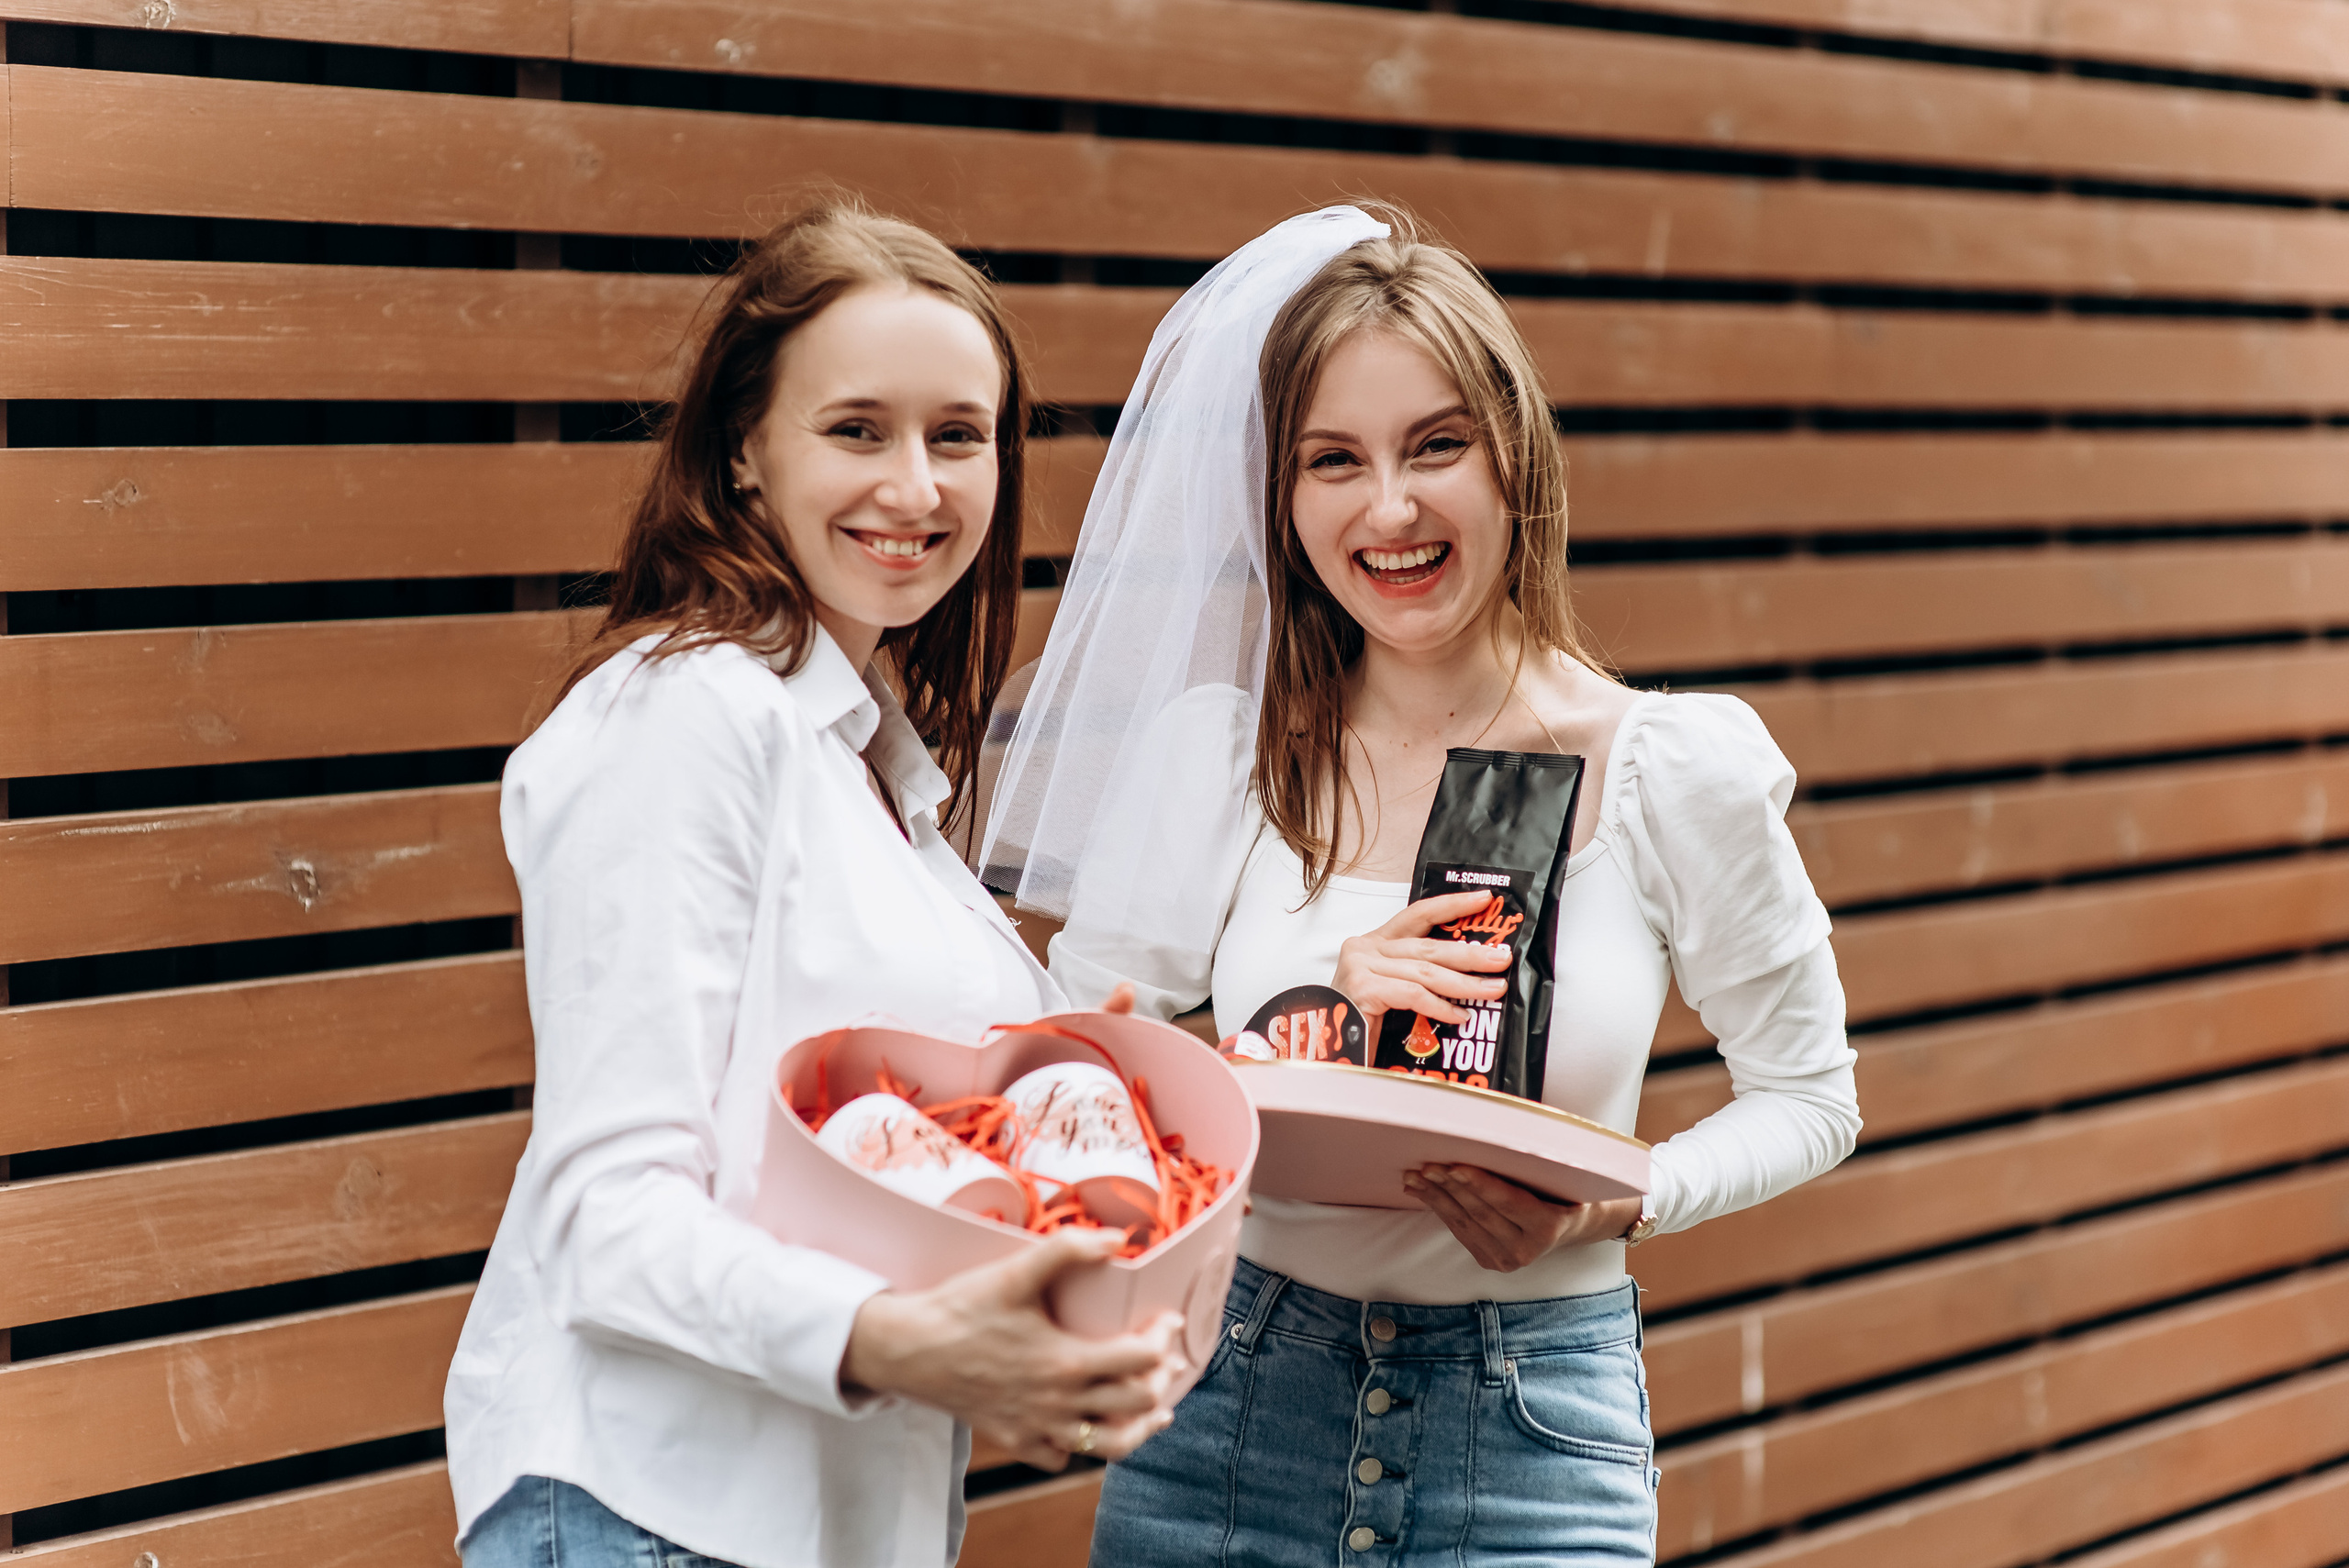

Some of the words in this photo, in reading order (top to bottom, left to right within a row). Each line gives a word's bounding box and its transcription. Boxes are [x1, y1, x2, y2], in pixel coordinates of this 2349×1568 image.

[1445, 871, 1510, 886] Mr.SCRUBBER
[1268, 1007, 1329, 1061] SEX
[1459, 1007, 1501, 1042] ON
[1442, 1038, 1497, 1073] YOU
